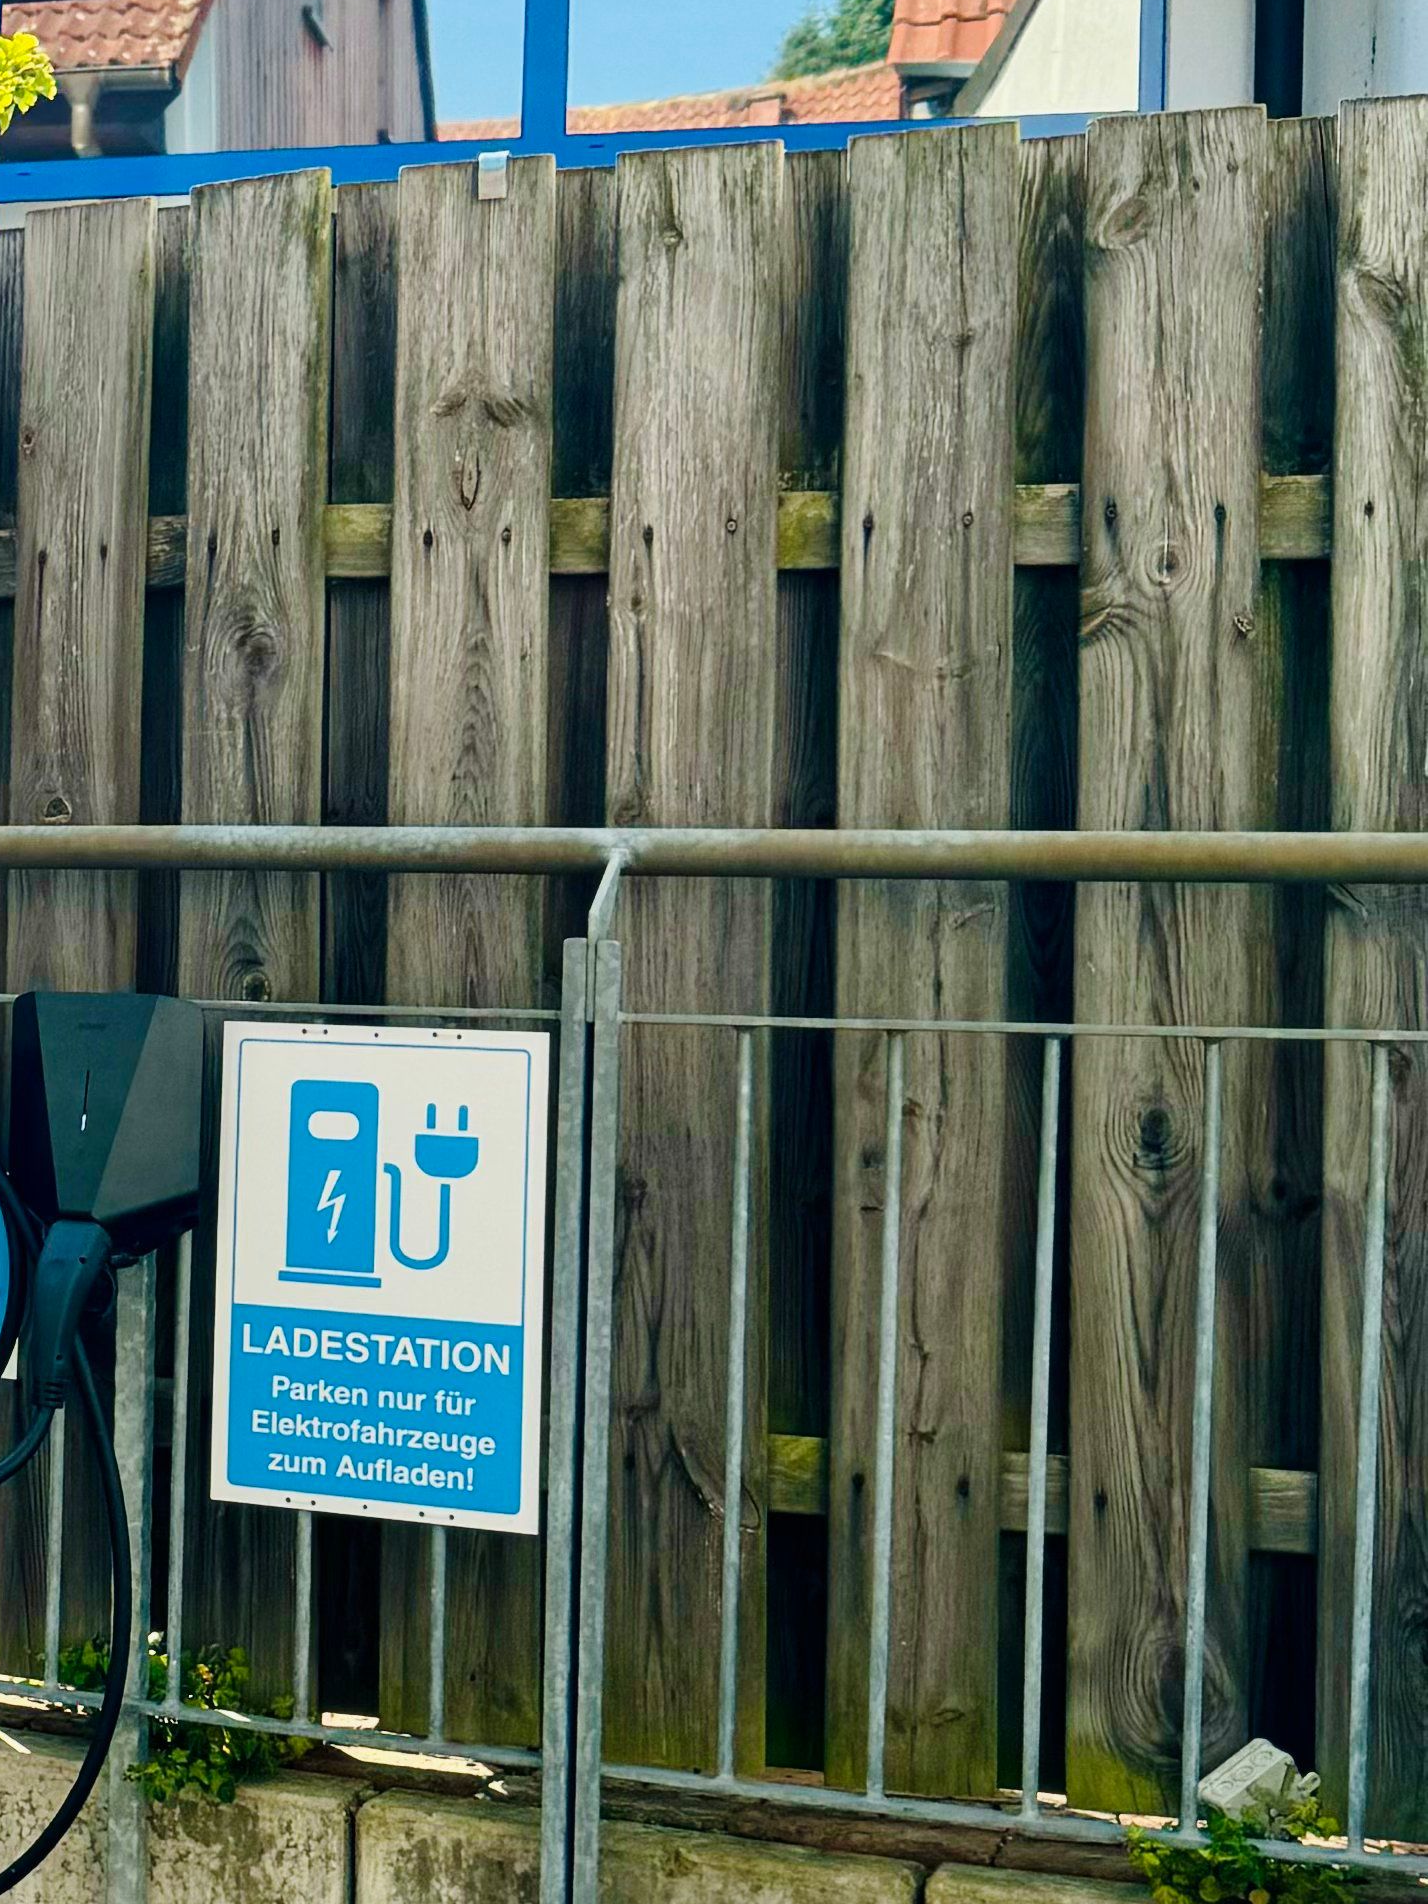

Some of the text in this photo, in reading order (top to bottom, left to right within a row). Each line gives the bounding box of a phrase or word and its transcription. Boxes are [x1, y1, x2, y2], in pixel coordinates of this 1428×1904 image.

[242, 1323, 510, 1376] LADESTATION
[272, 1375, 476, 1416] Parken nur für
[251, 1410, 496, 1460] Elektrofahrzeuge
[268, 1452, 474, 1492] zum Aufladen!
